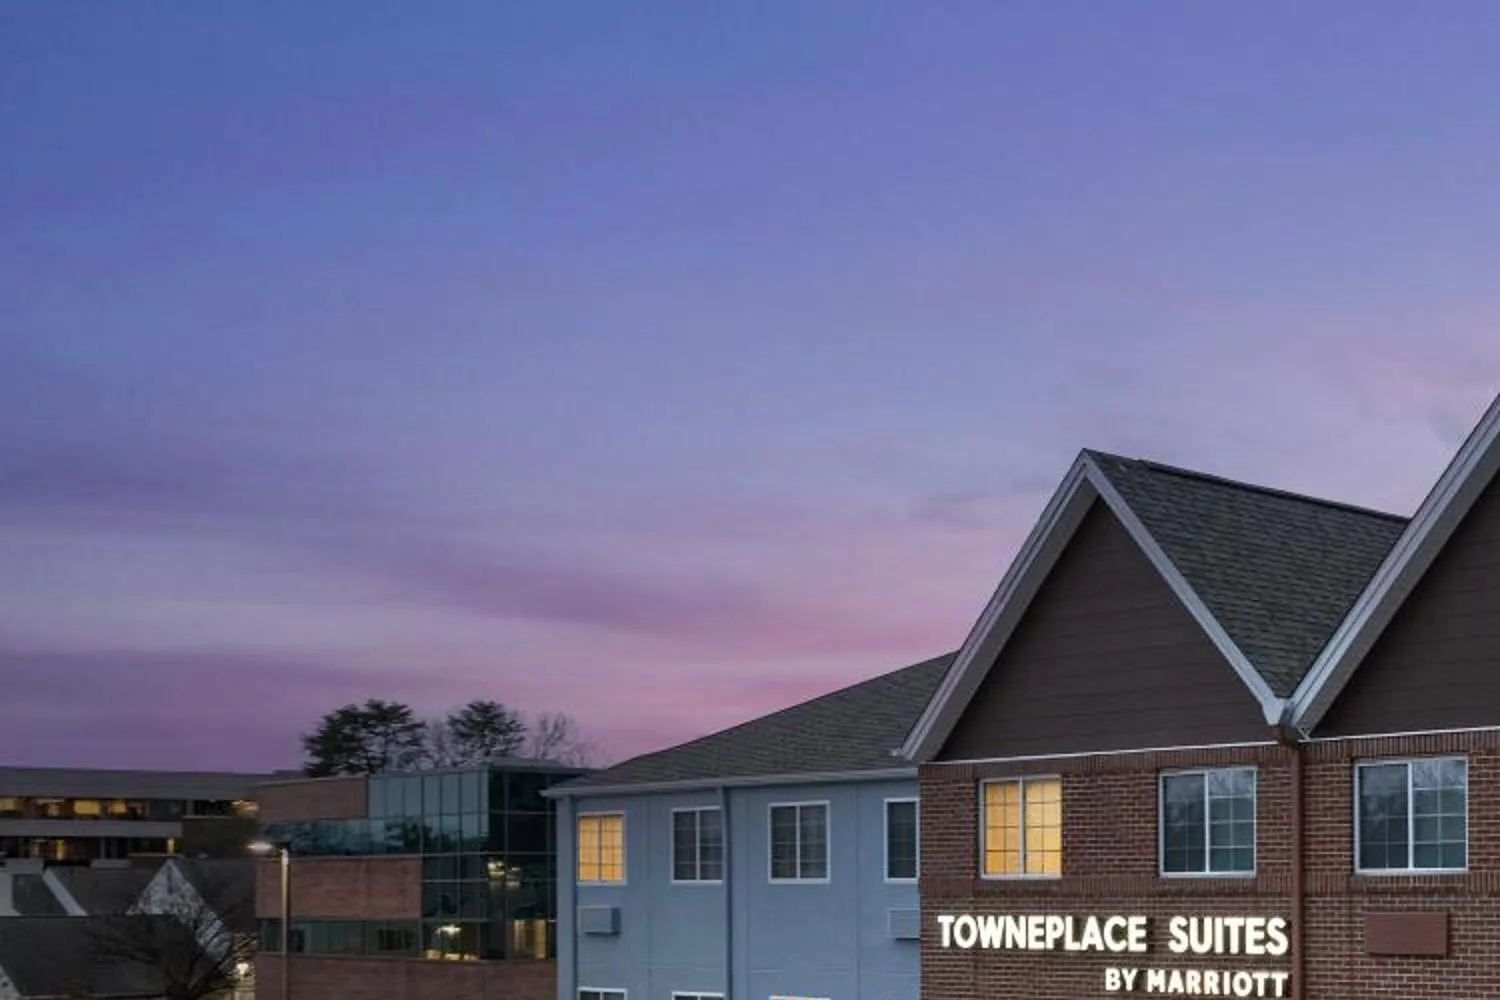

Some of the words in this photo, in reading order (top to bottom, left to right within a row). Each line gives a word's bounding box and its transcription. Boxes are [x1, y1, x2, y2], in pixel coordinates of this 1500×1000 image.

[937, 914, 1147, 952] TOWNEPLACE
[1168, 916, 1289, 955] SUITES
[1105, 968, 1138, 991] BY
[1147, 969, 1289, 997] MARRIOTT
